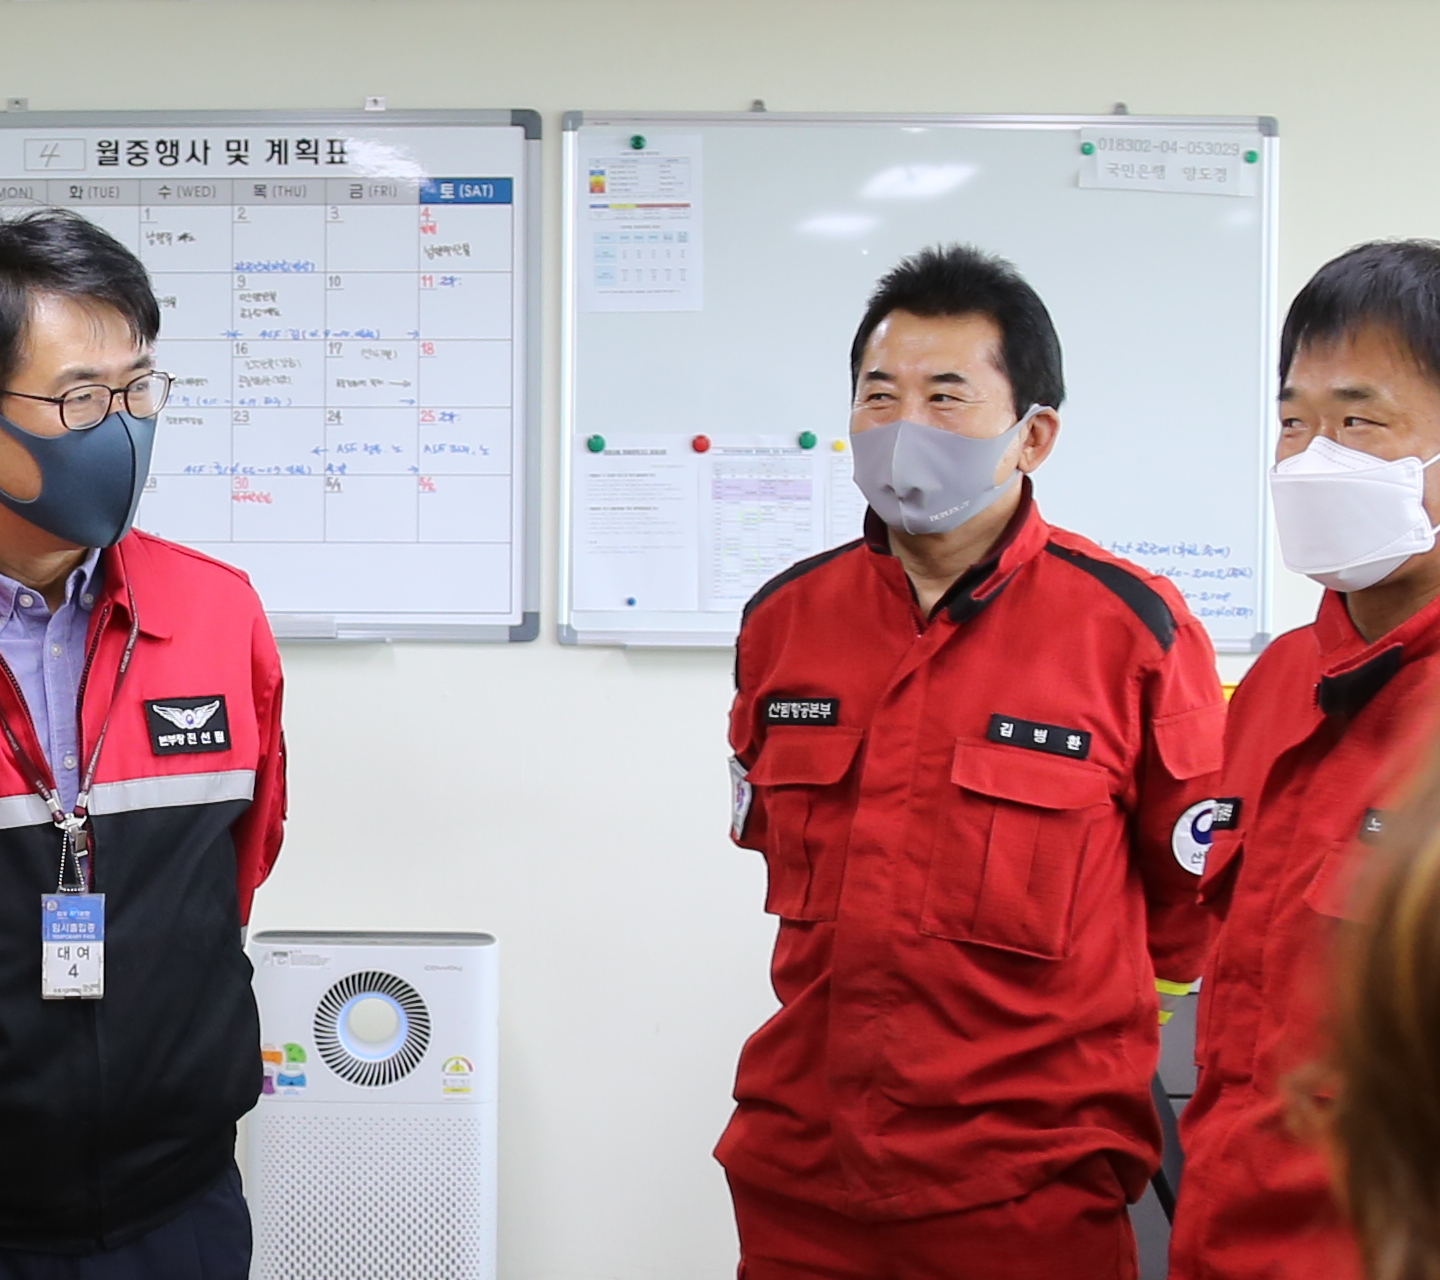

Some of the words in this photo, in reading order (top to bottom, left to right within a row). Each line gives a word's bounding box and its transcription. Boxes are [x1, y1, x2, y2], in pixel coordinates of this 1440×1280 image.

[39, 142, 61, 167] 4
[96, 138, 211, 167] 월중행사
[225, 138, 250, 166] 및
[265, 138, 348, 166] 계획표
[1106, 162, 1166, 180] 국민은행
[69, 185, 84, 200] 화
[87, 186, 120, 199] (TUE)
[158, 185, 172, 199] 수
[176, 185, 216, 199] (WED)
[253, 184, 267, 199] 목
[272, 185, 307, 198] (THU)
[350, 184, 363, 199] 금
[369, 185, 398, 198] (FRI)
[440, 183, 455, 199] 토
[459, 184, 494, 199] (SAT)
[144, 207, 151, 220] 1
[237, 207, 248, 220] 2
[330, 207, 340, 220] 3
[237, 274, 247, 288] 9
[328, 275, 341, 287] 10
[421, 275, 434, 287] 11
[235, 342, 249, 355] 16
[328, 342, 342, 355] 17
[421, 342, 435, 355] 18
[234, 410, 250, 422] 23
[328, 410, 342, 424] 24
[421, 410, 436, 422] 25
[234, 476, 249, 489] 30
[768, 701, 832, 719] 산림항공본부
[68, 963, 80, 979] 4
